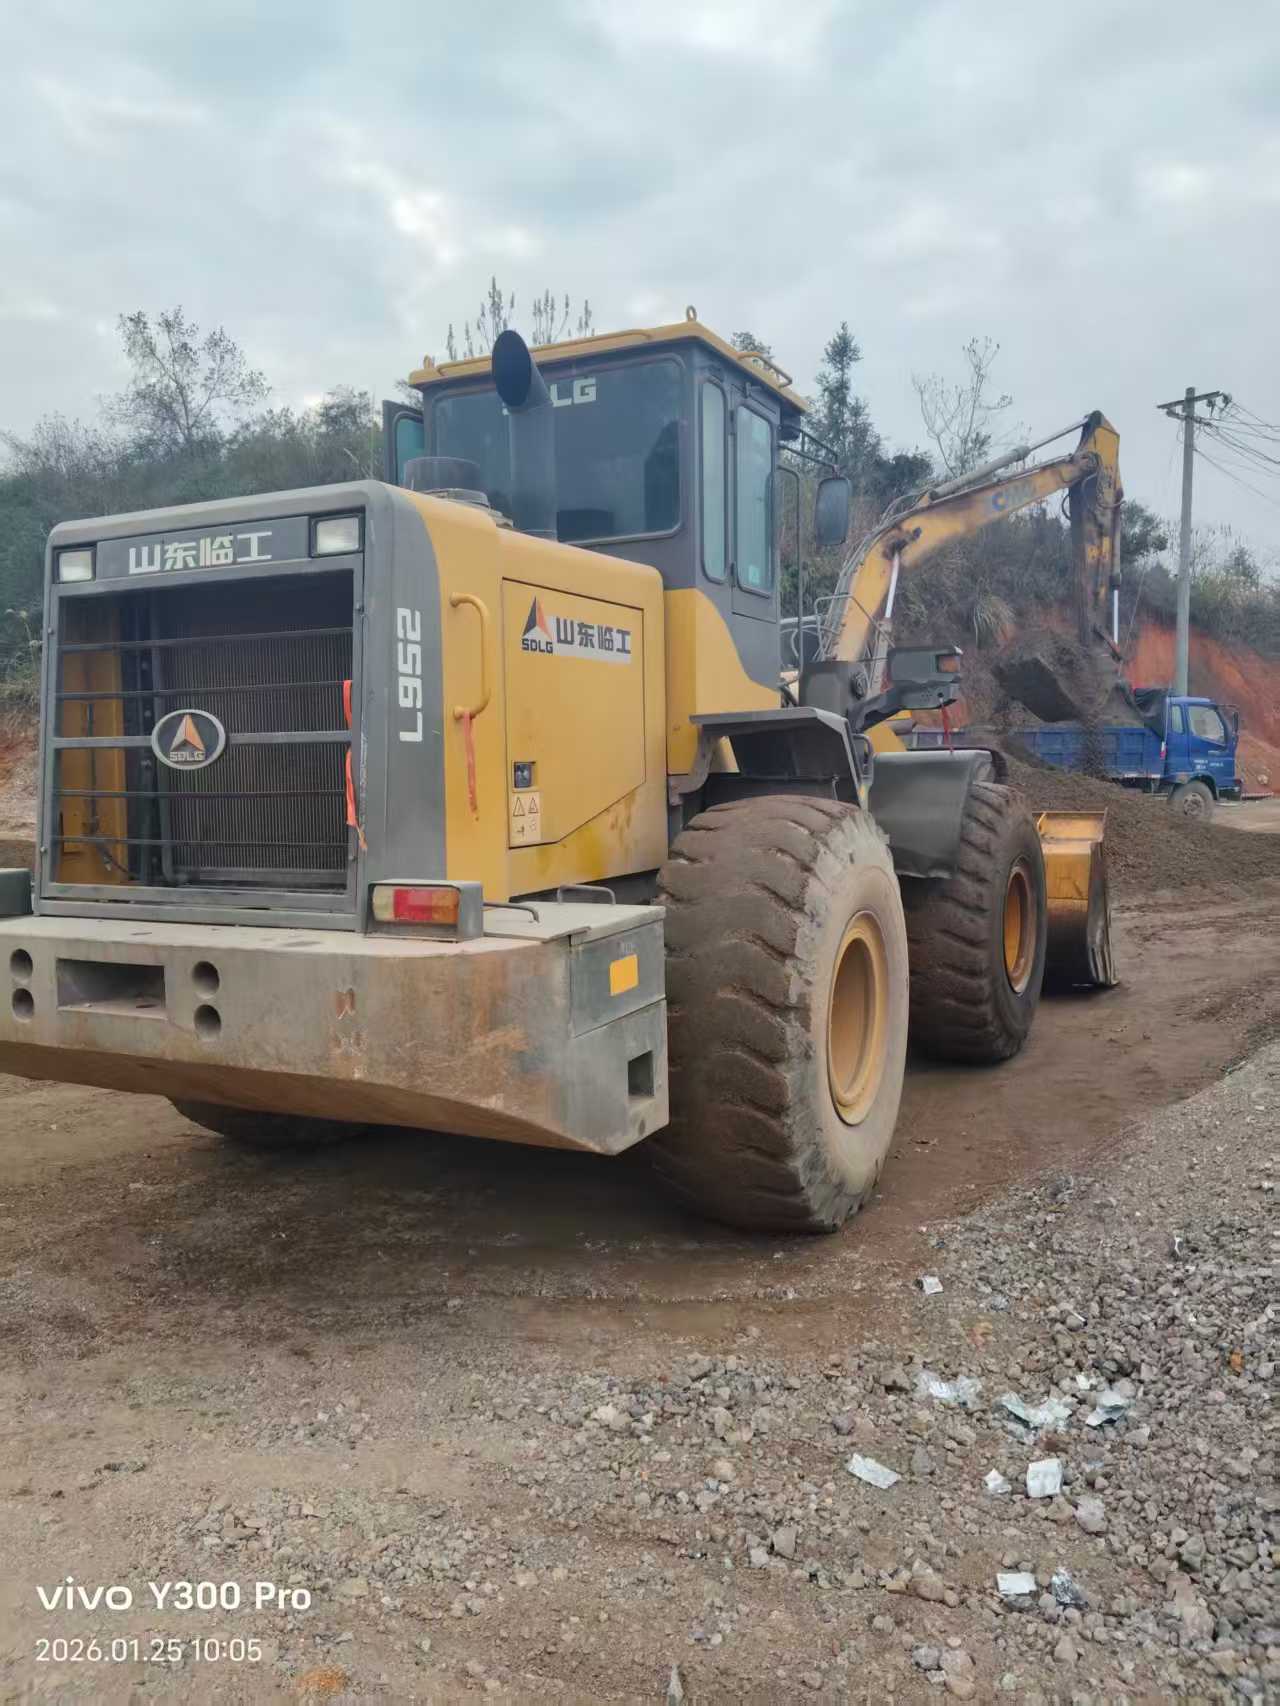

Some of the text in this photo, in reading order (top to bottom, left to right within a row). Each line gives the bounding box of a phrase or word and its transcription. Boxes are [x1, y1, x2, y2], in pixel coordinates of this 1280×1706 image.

[128, 531, 272, 575] 山东临工
[522, 638, 554, 654] SDLG
[556, 617, 631, 655] 山东临工
[397, 607, 423, 742] L952
[169, 751, 206, 761] SDLG
